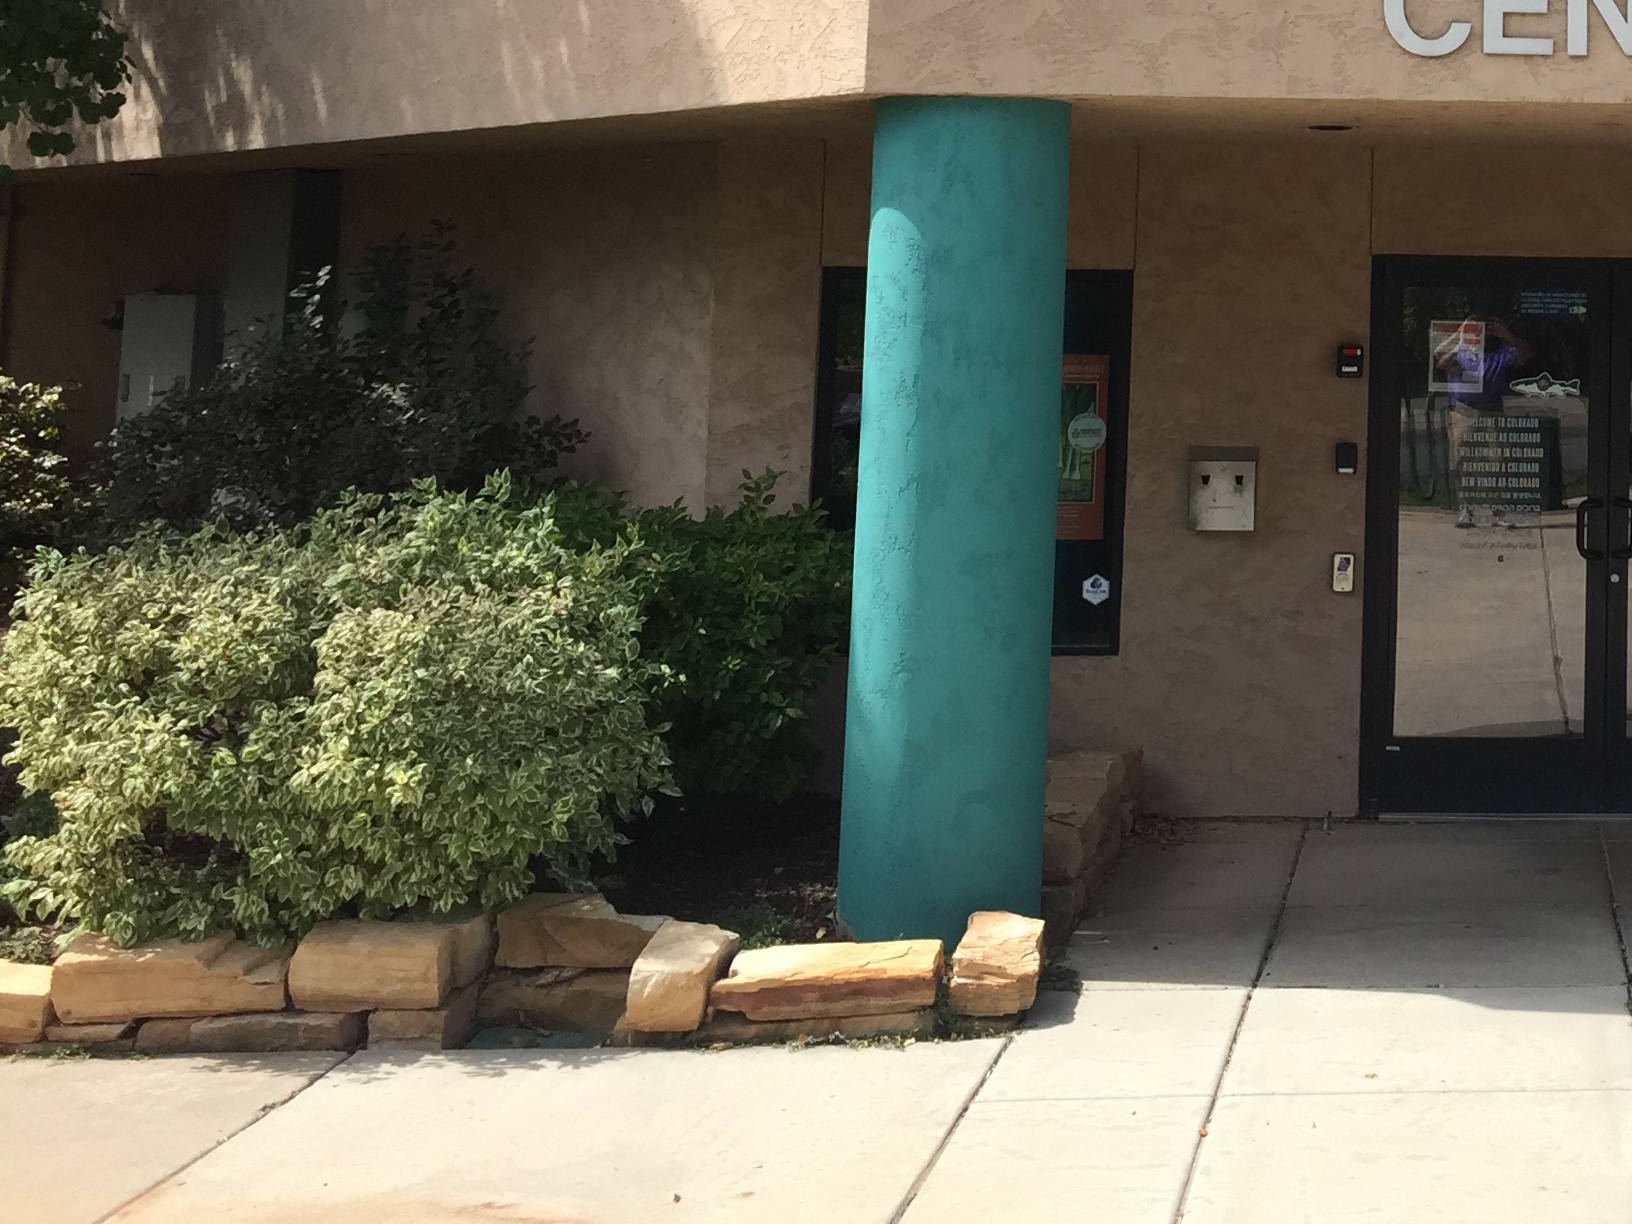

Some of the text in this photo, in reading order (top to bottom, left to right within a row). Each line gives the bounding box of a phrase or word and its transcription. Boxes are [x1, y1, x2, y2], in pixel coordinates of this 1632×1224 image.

[1507, 417, 1539, 428] COLORADO
[1508, 432, 1541, 443] COLORADO
[1511, 447, 1544, 458] COLORADO
[1507, 462, 1540, 473] COLORADO
[1508, 477, 1540, 488] COLORADO
